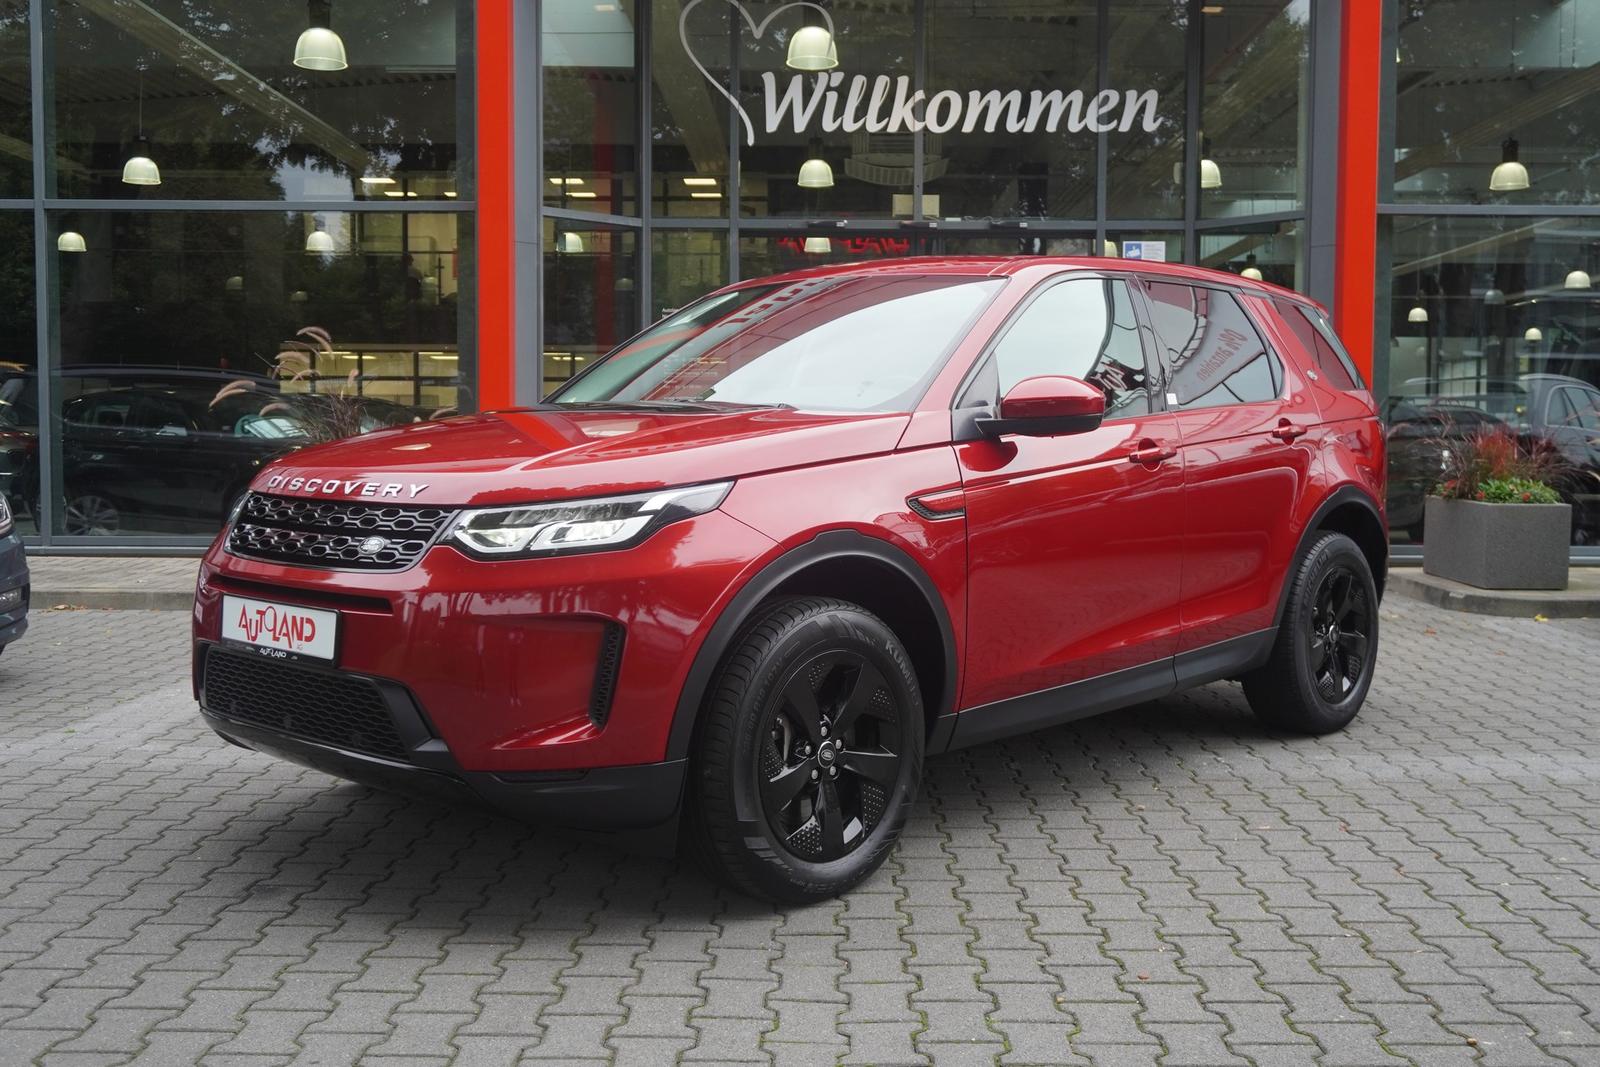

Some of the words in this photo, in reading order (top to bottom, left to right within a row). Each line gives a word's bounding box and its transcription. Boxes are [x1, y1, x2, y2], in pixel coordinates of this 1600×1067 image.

[761, 71, 1162, 134] Willkommen
[267, 475, 430, 498] DISCOVERY
[238, 603, 316, 649] AUTOLAND
